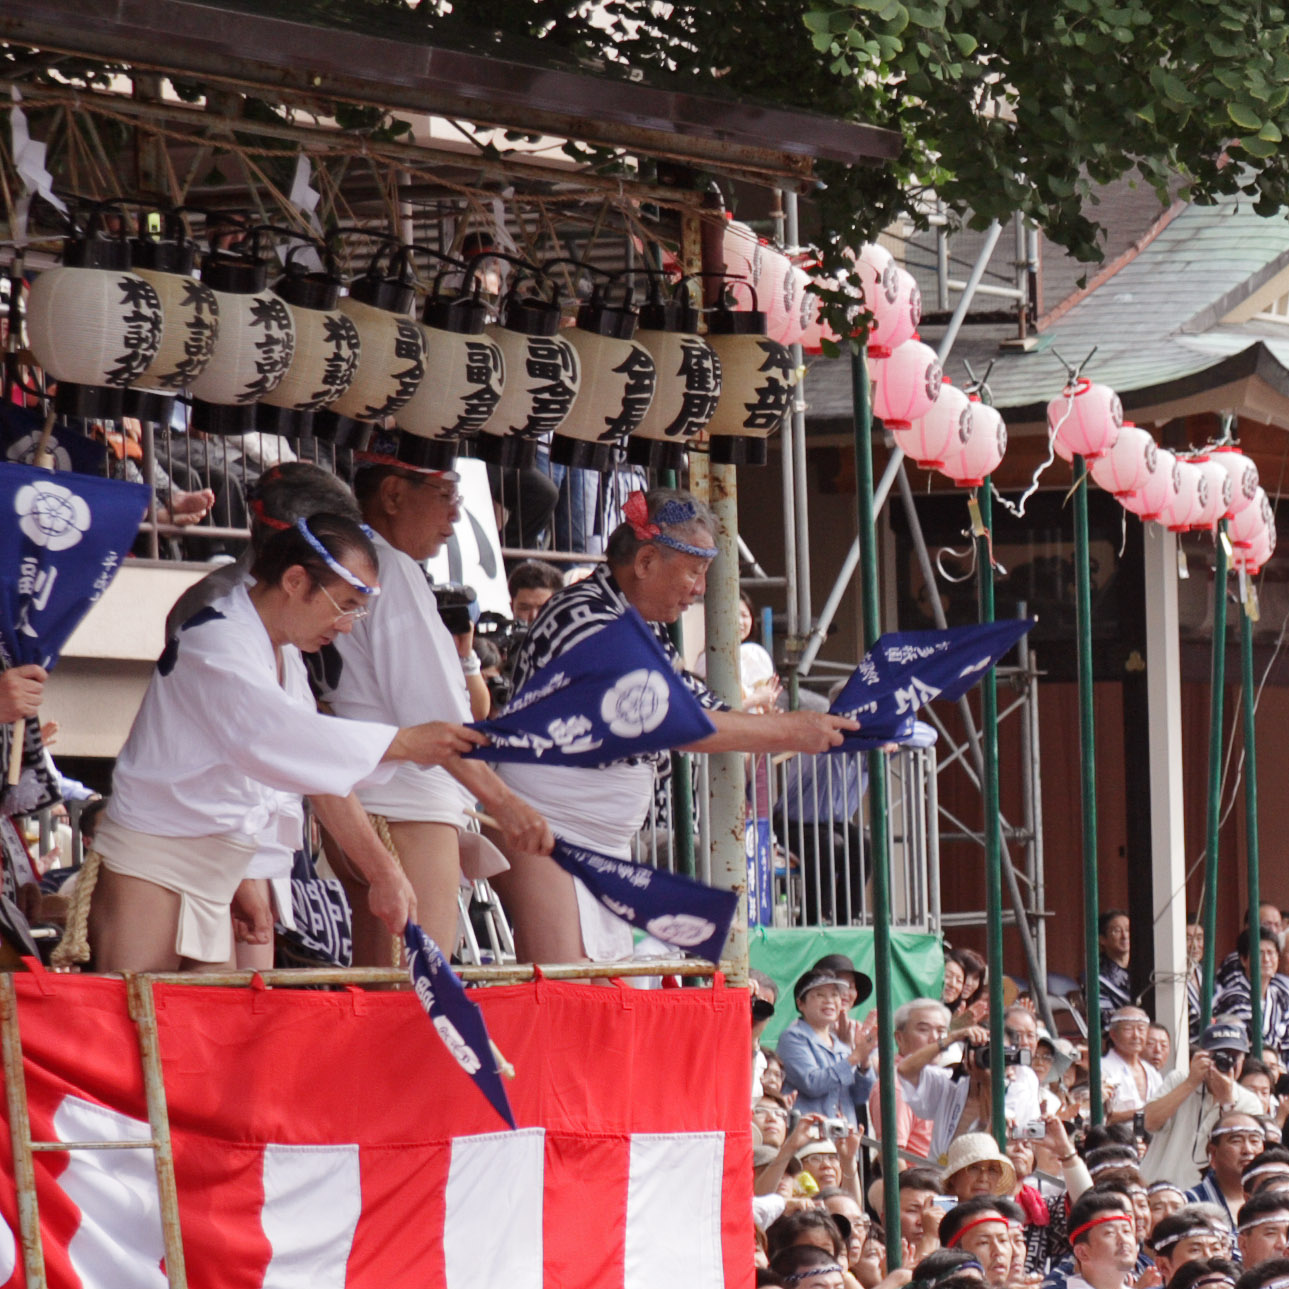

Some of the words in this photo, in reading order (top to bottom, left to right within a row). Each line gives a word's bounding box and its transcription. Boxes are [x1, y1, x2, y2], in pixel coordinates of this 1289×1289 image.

[105, 276, 163, 387] 相談役
[434, 340, 504, 440] 副会長
[505, 337, 577, 438] 副会長
[596, 345, 656, 442] 会長
[664, 338, 722, 436] 顧問
[743, 340, 797, 430] 本部
